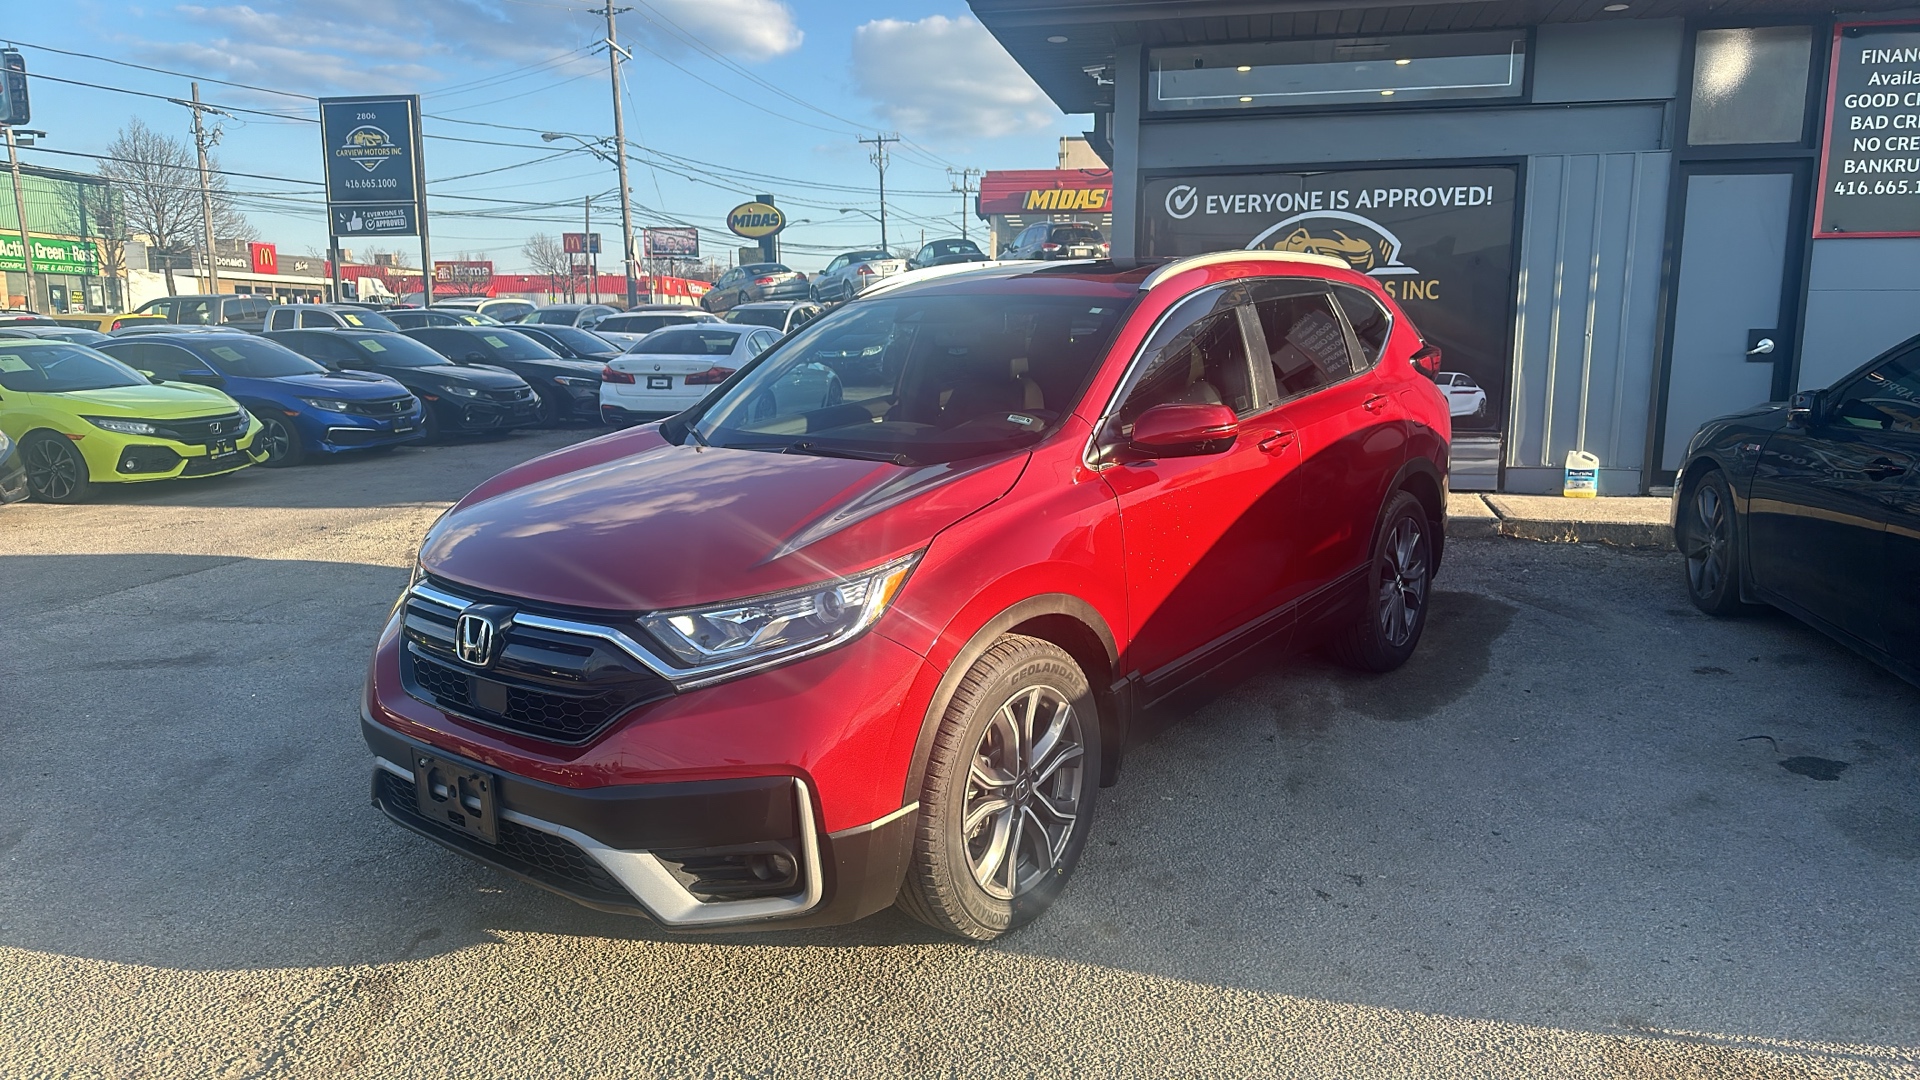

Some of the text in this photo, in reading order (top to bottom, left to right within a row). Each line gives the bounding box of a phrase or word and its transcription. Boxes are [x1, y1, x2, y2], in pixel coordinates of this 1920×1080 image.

[1861, 48, 1920, 64] FINAN
[1844, 93, 1899, 108] GOOD
[356, 112, 376, 120] 2806
[1850, 114, 1920, 130] BAD CR
[336, 147, 402, 157] CARVIEW MOTORS INC
[1853, 137, 1881, 152] NO
[345, 178, 397, 189] 416.665.1000
[1027, 188, 1105, 210] MIDAS
[1206, 185, 1493, 214] EVERYONE IS APPROVED!
[367, 209, 397, 218] EVERYONE
[732, 213, 779, 228] MIDAS
[376, 218, 405, 228] APPROVED
[1402, 280, 1440, 300] INC
[1011, 662, 1080, 690] GEOLANDAR
[969, 894, 1010, 926] OKOHAMA
